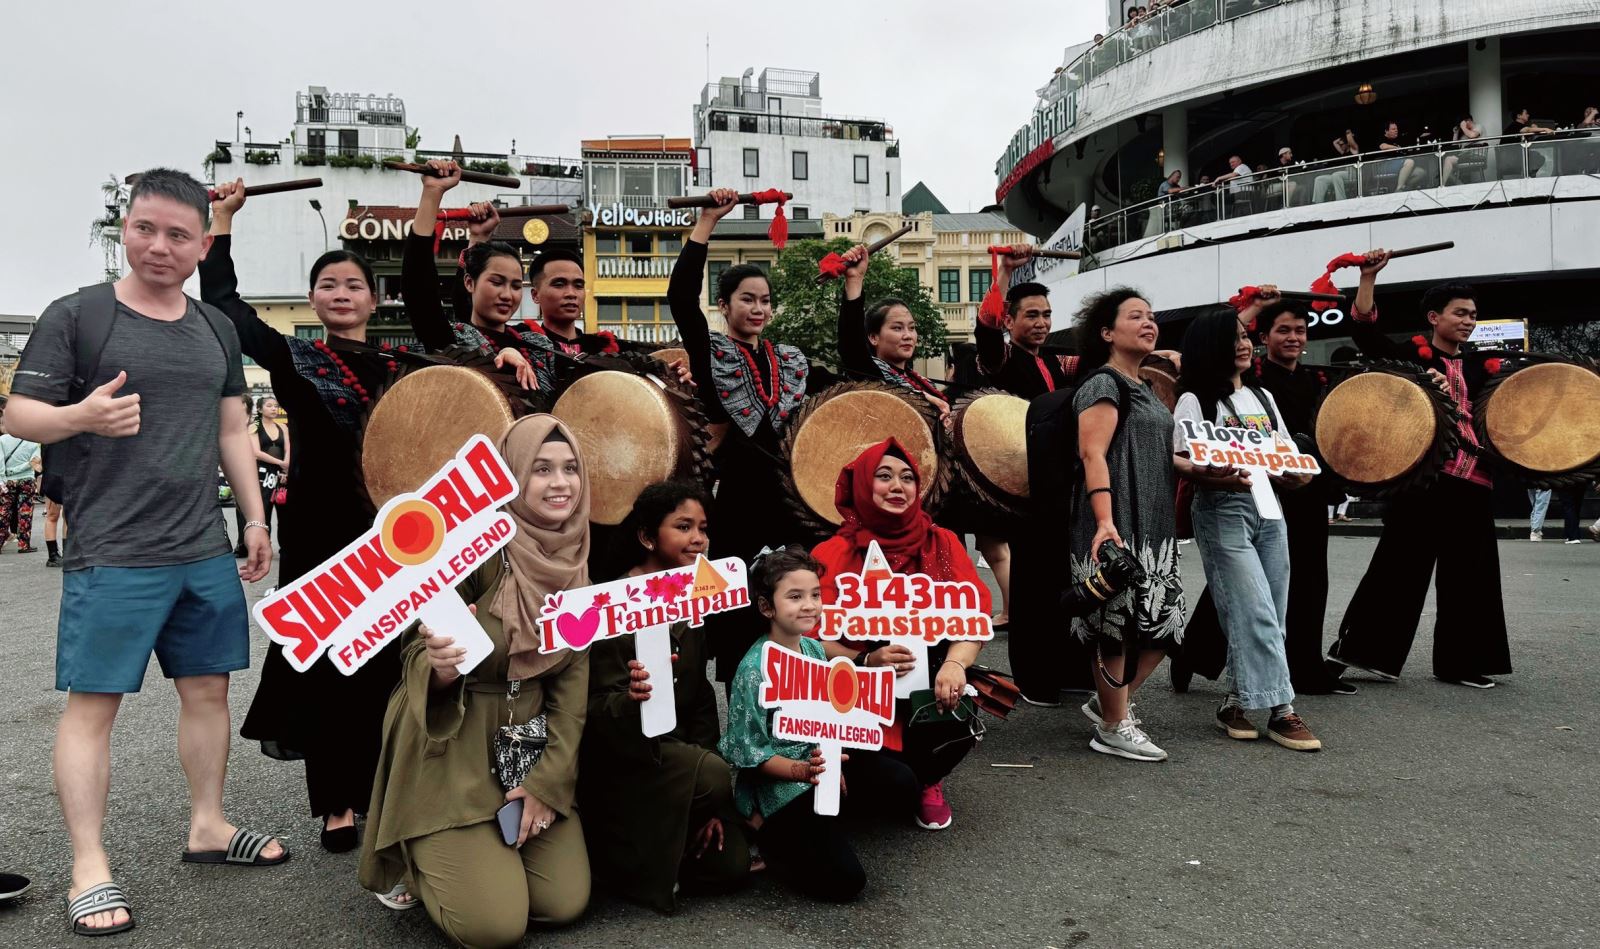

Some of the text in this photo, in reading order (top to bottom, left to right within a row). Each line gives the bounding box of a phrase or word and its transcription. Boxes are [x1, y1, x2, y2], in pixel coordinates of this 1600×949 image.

[1182, 420, 1262, 444] I love
[1190, 442, 1317, 471] Fansipan
[338, 518, 511, 667] FANSIPAN LEGEND
[839, 576, 977, 609] 3143m
[540, 586, 749, 652] I Fansipan
[822, 608, 990, 641] Fansipan
[779, 716, 881, 745] FANSIPAN LEGEND
